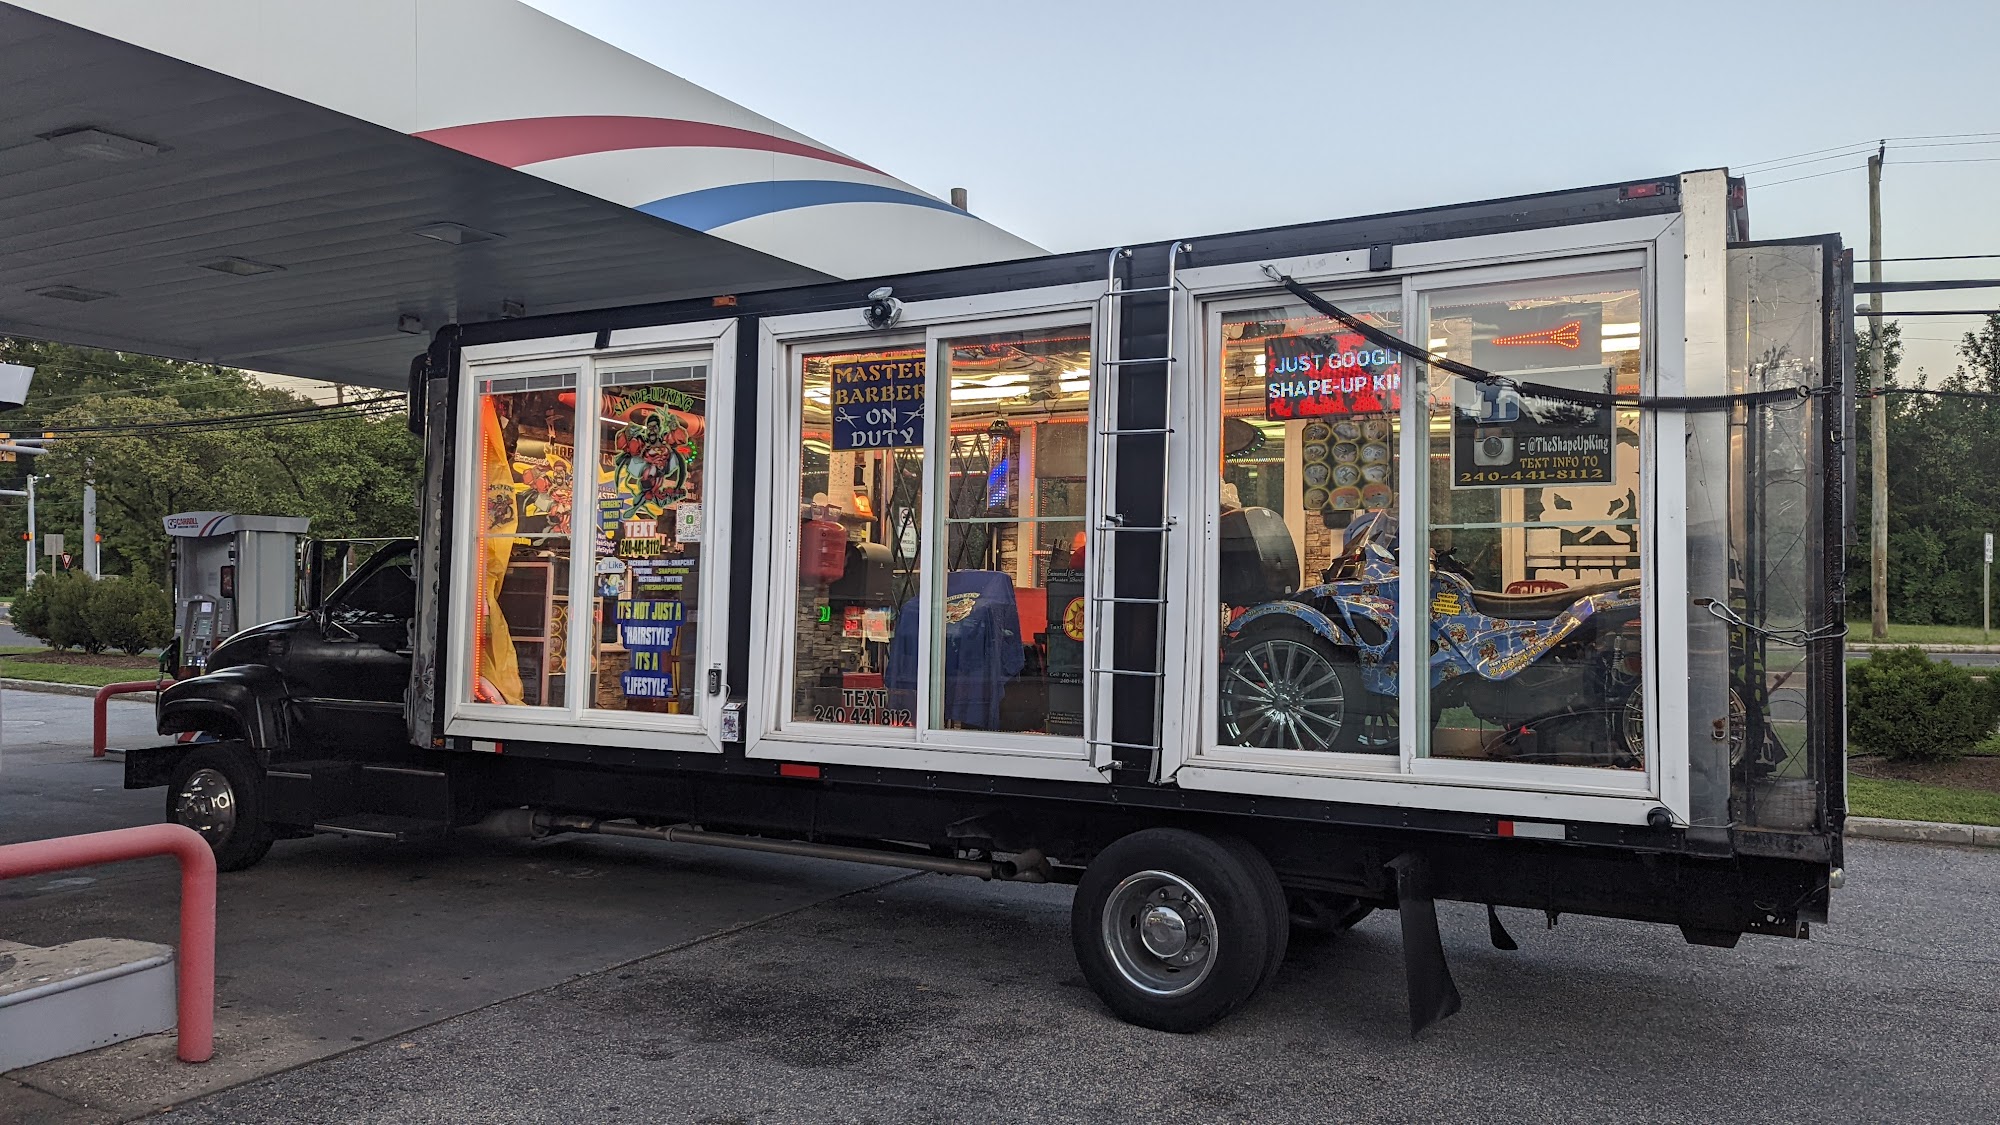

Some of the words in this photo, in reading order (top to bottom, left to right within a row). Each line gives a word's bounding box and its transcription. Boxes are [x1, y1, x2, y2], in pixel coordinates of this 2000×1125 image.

[835, 362, 925, 383] MASTER
[1275, 353, 1324, 374] JUST
[835, 384, 925, 405] BARBER
[1269, 376, 1367, 398] SHAPE-UP
[614, 387, 664, 416] SHAPE-UP
[665, 388, 694, 412] KING
[866, 408, 897, 425] ON
[851, 427, 914, 447] DUTY
[1527, 435, 1609, 455] @TheShapeUpKing
[1520, 457, 1550, 468] TEXT
[1553, 456, 1579, 468] INFO
[1583, 455, 1598, 467] TO
[1460, 469, 1603, 482] 240-441-8112
[177, 517, 198, 525] CARROLL
[624, 521, 657, 538] TEXT
[621, 539, 660, 555] 240-441-8112
[609, 561, 623, 569] Like
[617, 602, 631, 619] IT'S
[633, 602, 650, 619] NOT
[652, 602, 674, 620] JUST
[675, 603, 681, 620] A
[635, 652, 650, 670] IT'S
[652, 653, 658, 670] A
[842, 689, 887, 708] TEXT
[814, 705, 846, 723] 240
[849, 707, 879, 726] 441
[882, 709, 913, 727] 8112
